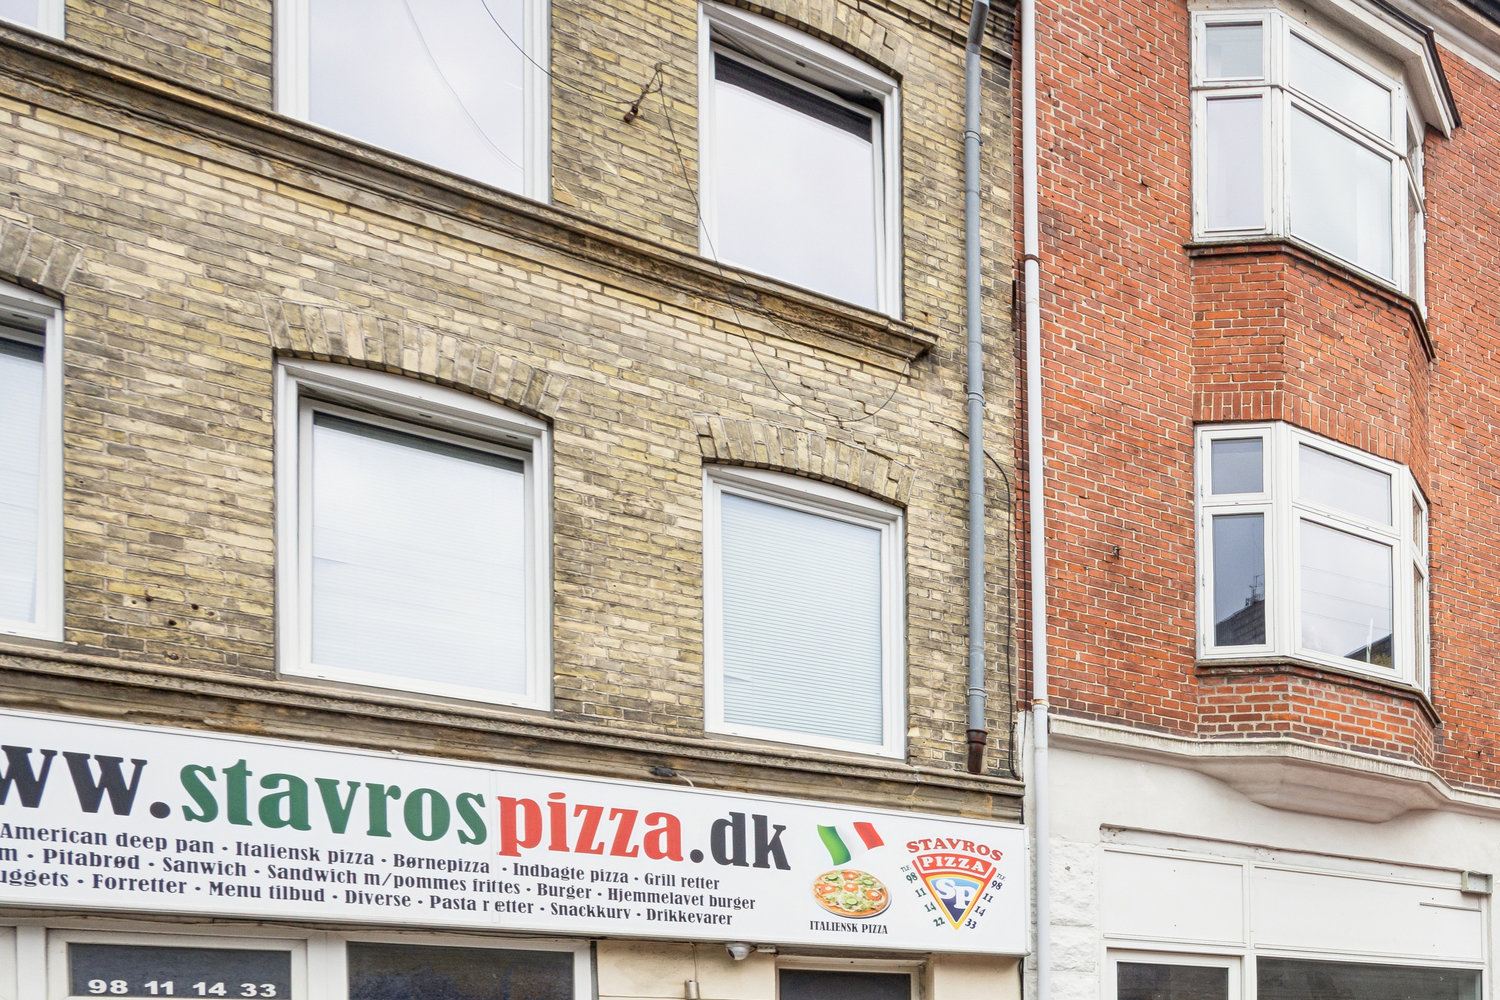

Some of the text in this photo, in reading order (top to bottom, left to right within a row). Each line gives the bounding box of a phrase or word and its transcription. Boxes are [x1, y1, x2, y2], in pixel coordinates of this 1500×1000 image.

[906, 838, 1004, 861] STAVROS
[1, 823, 720, 891] American deep pan Italiensk pizza Børnepizza Indbagte pizza Grill retter
[921, 856, 986, 873] PIZZA
[43, 848, 140, 869] Pitabrød
[163, 857, 247, 876] Sanwich
[268, 864, 357, 885] Sandwich
[364, 872, 466, 891] m/pommes
[537, 882, 592, 900] Burger
[608, 887, 704, 906] Hjemmelavet
[709, 894, 756, 911] burger
[905, 872, 918, 883] 98
[990, 880, 1003, 891] 98
[92, 874, 187, 894] Forretter
[209, 881, 262, 898] Menu
[269, 885, 325, 902] tilbud
[345, 890, 411, 907] Diverse
[430, 895, 476, 911] Pasta
[551, 902, 631, 919] Snackkurv
[646, 908, 732, 925] Drikkevarer
[915, 888, 927, 898] 11
[935, 878, 975, 910] SP
[982, 893, 994, 903] 11
[924, 902, 937, 912] 14
[974, 906, 986, 917] 14
[809, 920, 888, 935] ITALIENSK PIZZA
[933, 917, 945, 927] 22
[964, 919, 977, 930] 33
[88, 979, 277, 998] 98 11 14 33
